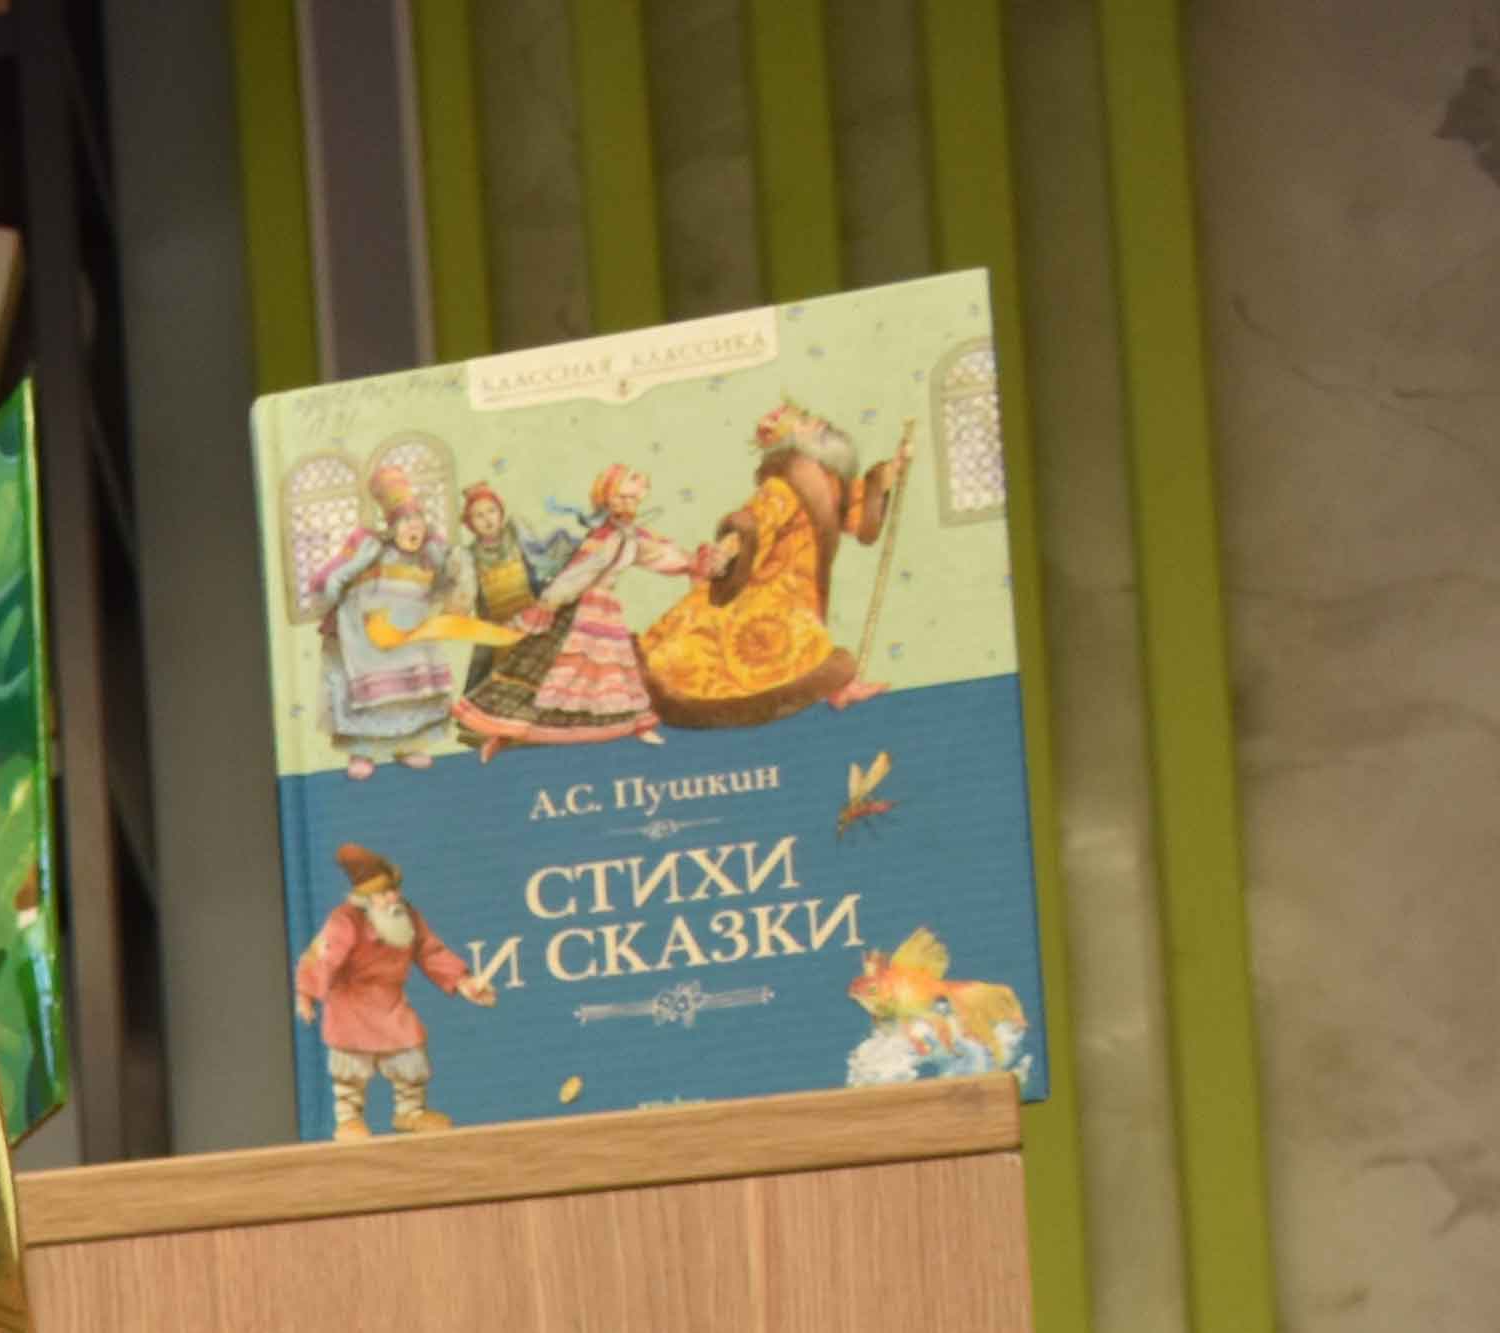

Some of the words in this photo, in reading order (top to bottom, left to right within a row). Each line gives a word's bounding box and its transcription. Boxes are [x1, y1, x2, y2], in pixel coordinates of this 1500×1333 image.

[630, 329, 767, 369] КЛАССИКА
[529, 783, 603, 821] А.С.
[613, 765, 780, 816] Пушкин
[525, 835, 801, 920] СТИХИ
[466, 936, 526, 991] И
[546, 893, 865, 982] СКАЗКИ
